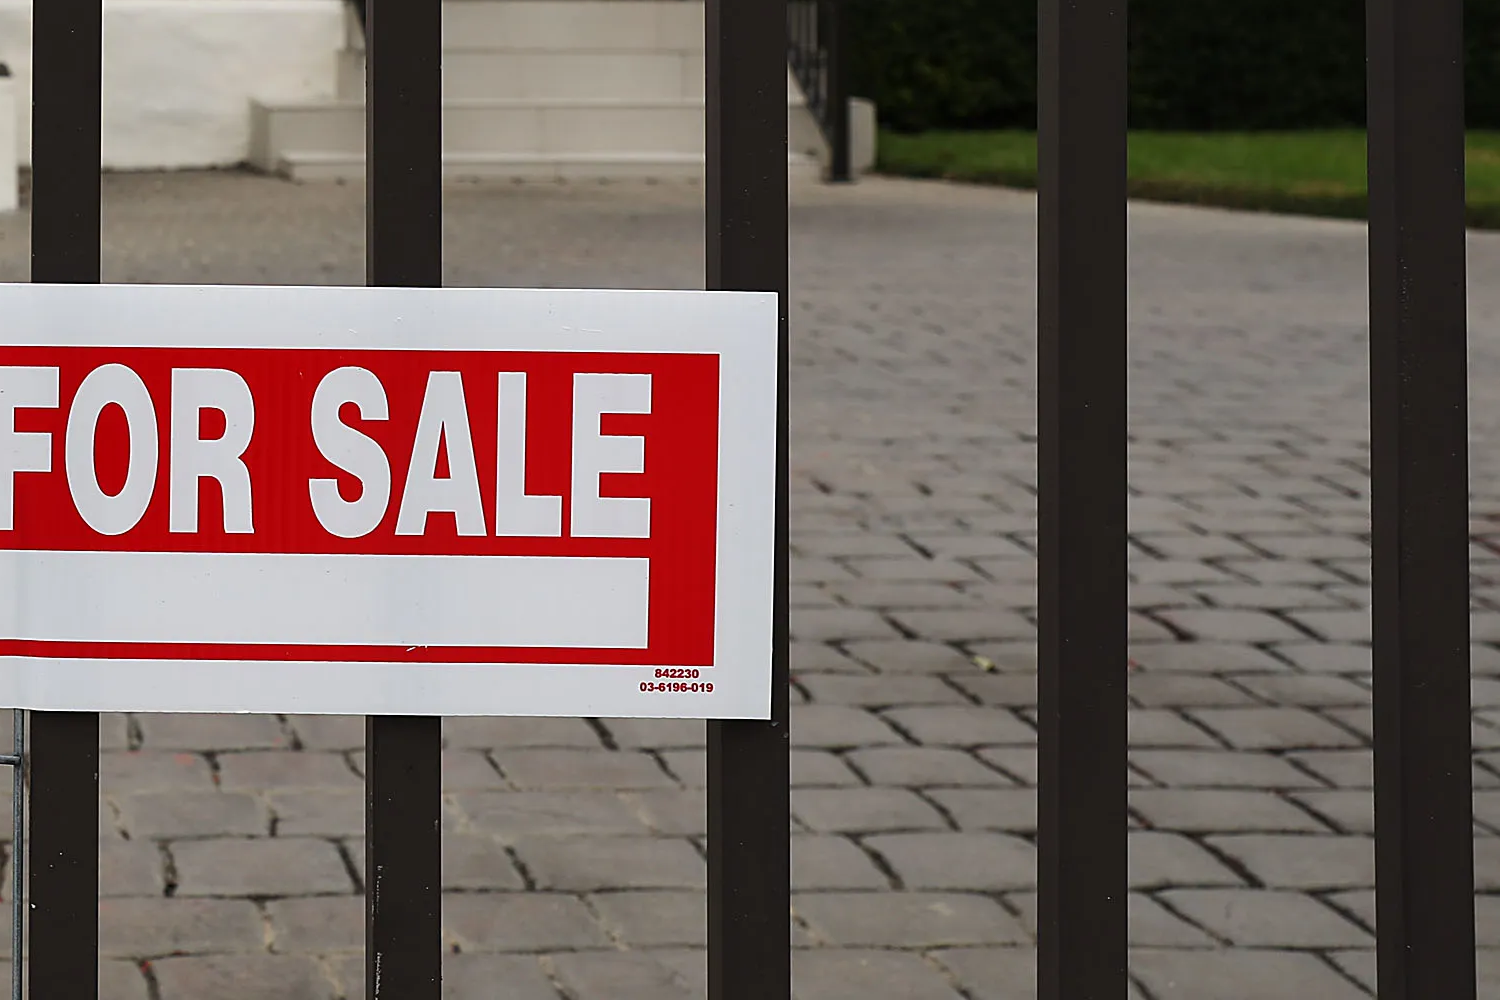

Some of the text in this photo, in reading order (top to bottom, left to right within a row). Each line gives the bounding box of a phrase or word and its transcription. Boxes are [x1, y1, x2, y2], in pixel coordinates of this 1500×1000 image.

[308, 365, 652, 539] SALE
[654, 668, 700, 679] 842230
[639, 682, 714, 693] 03-6196-019
